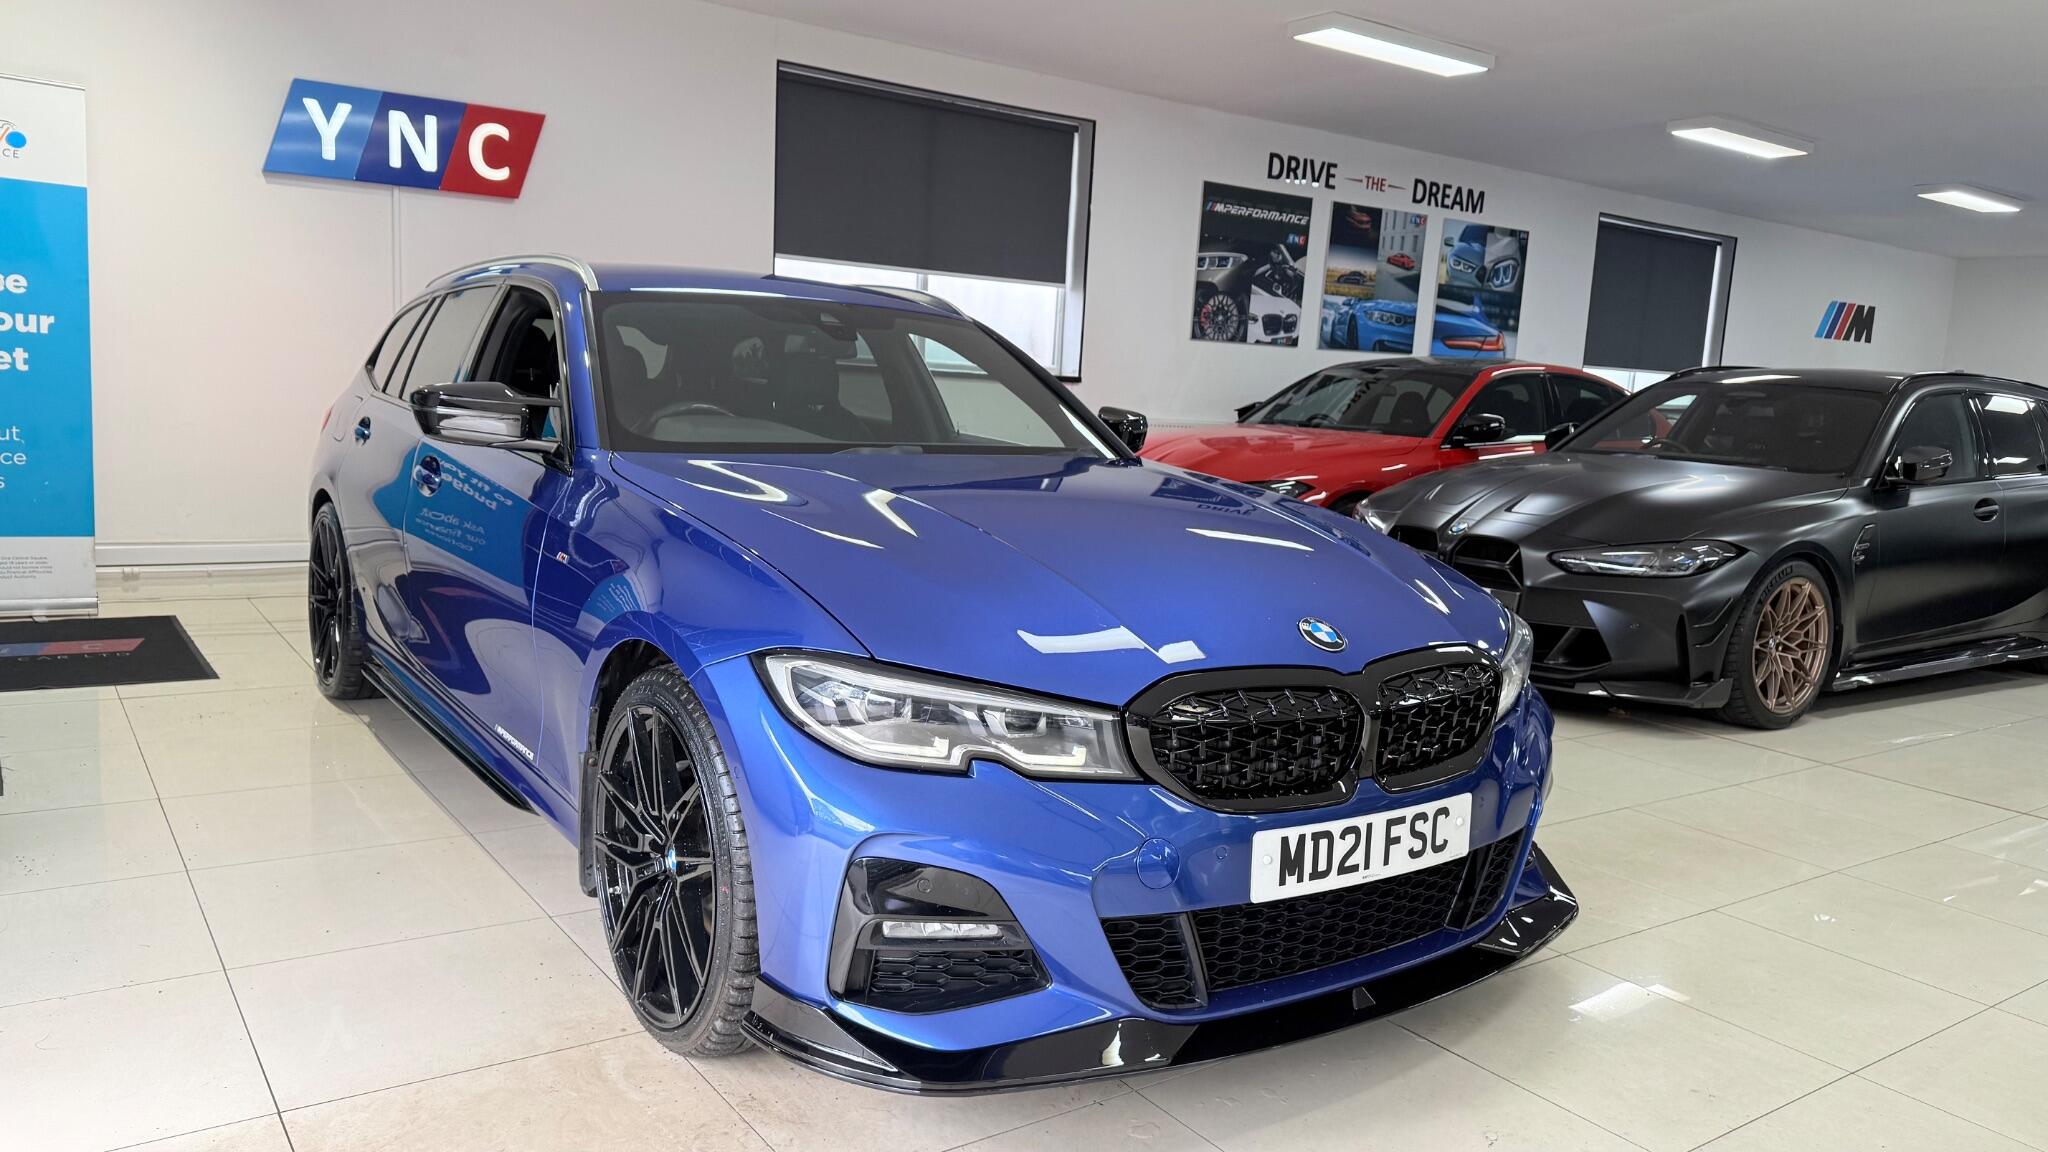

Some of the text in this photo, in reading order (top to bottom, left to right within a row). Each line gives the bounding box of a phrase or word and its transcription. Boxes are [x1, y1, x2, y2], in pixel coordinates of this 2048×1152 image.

[302, 96, 511, 181] YNC
[1267, 152, 1486, 215] DRIVE THE DREAM
[0, 273, 27, 294] e
[1278, 806, 1451, 887] MD21 FSC
